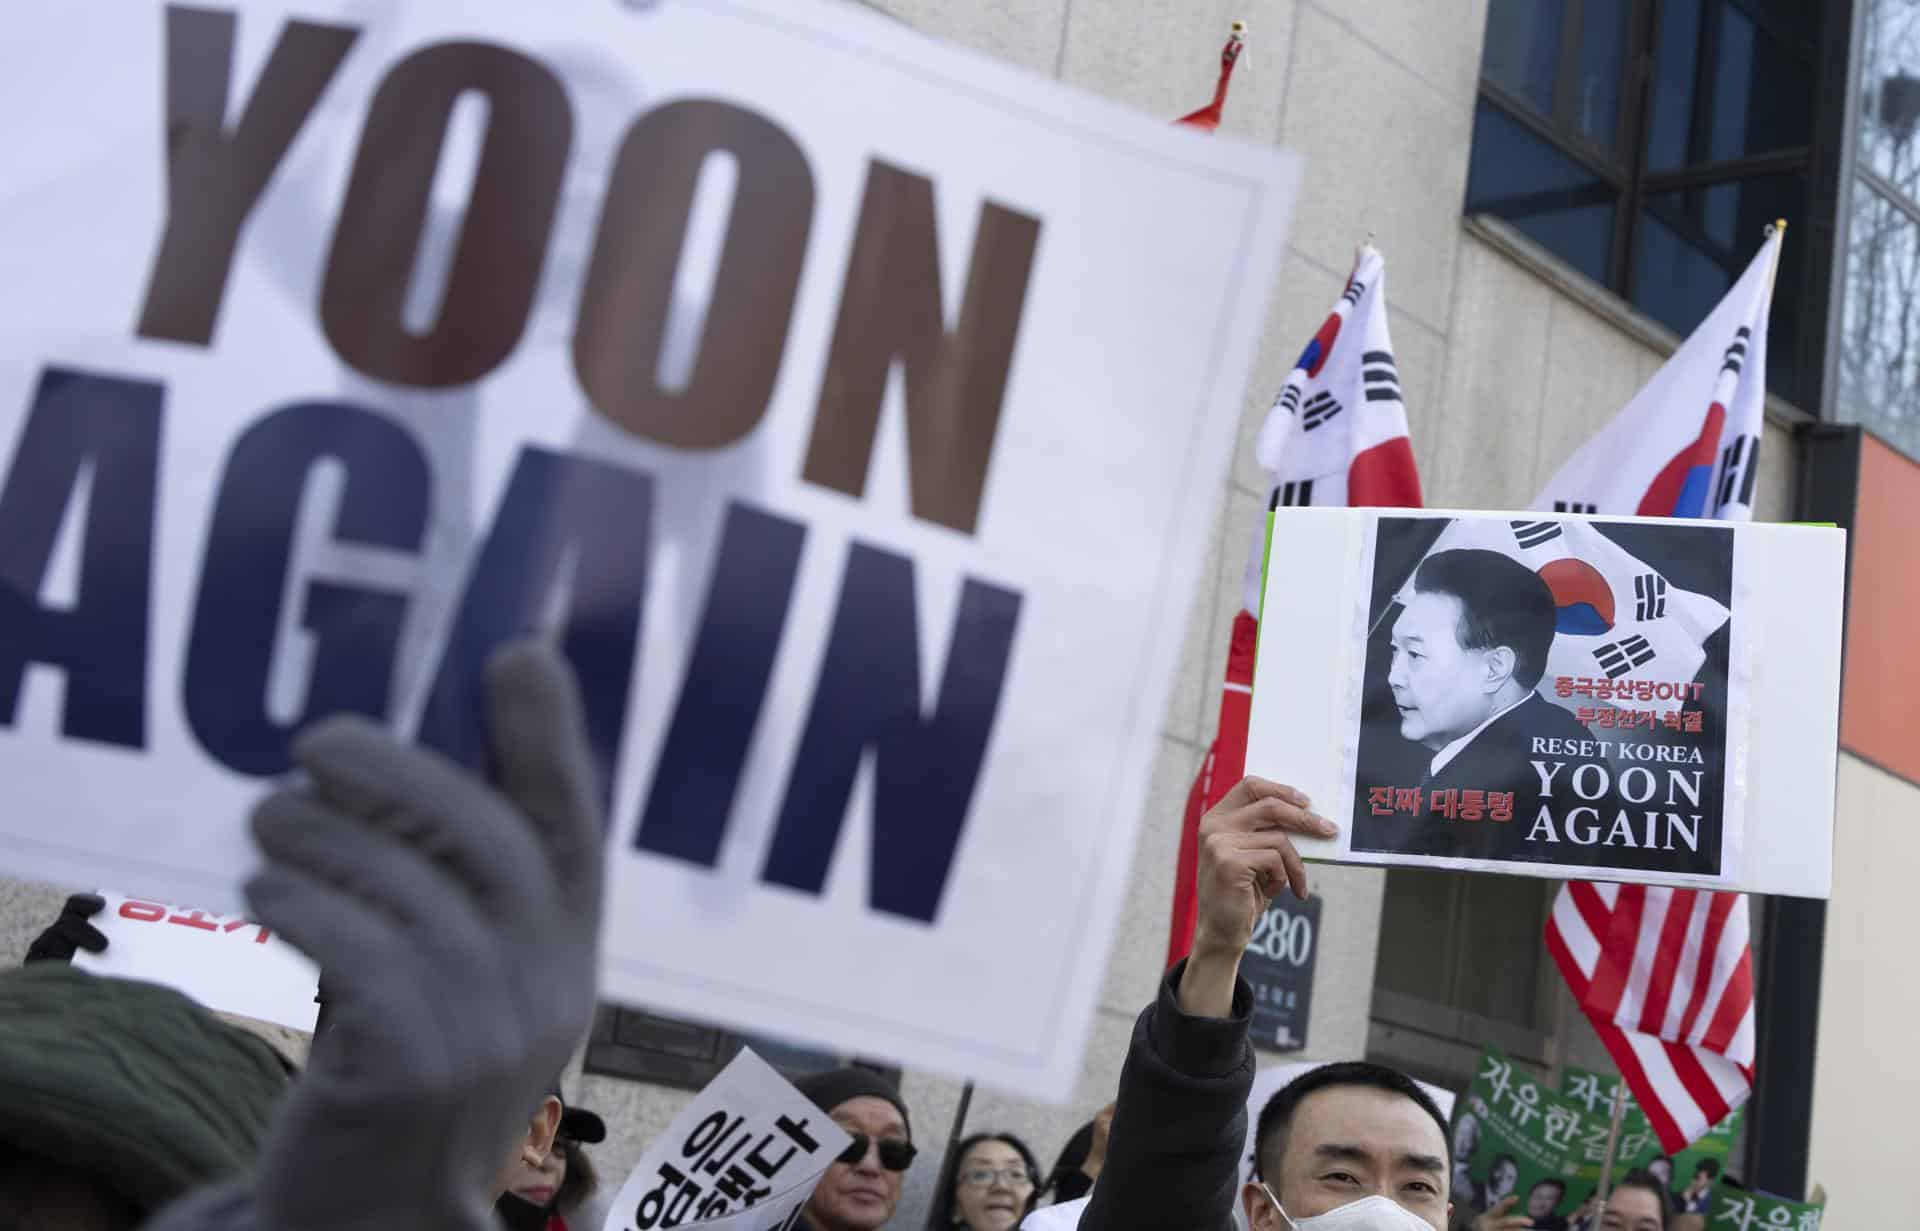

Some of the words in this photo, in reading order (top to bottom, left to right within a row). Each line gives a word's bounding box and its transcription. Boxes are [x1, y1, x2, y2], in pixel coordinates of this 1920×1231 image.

[135, 4, 1043, 537] YOON
[0, 363, 1024, 927] AGAIN
[1554, 676, 1704, 702] 중국공산당OUT
[1576, 706, 1655, 731] 부정선거
[1663, 710, 1704, 733] 척결
[1531, 736, 1612, 759] RESET
[1619, 741, 1704, 764] KOREA
[1367, 784, 1423, 817] 진짜
[1431, 788, 1515, 823] 대통령
[1530, 761, 1704, 808] YOON
[1525, 806, 1703, 852] AGAIN
[1246, 907, 1312, 966] 280
